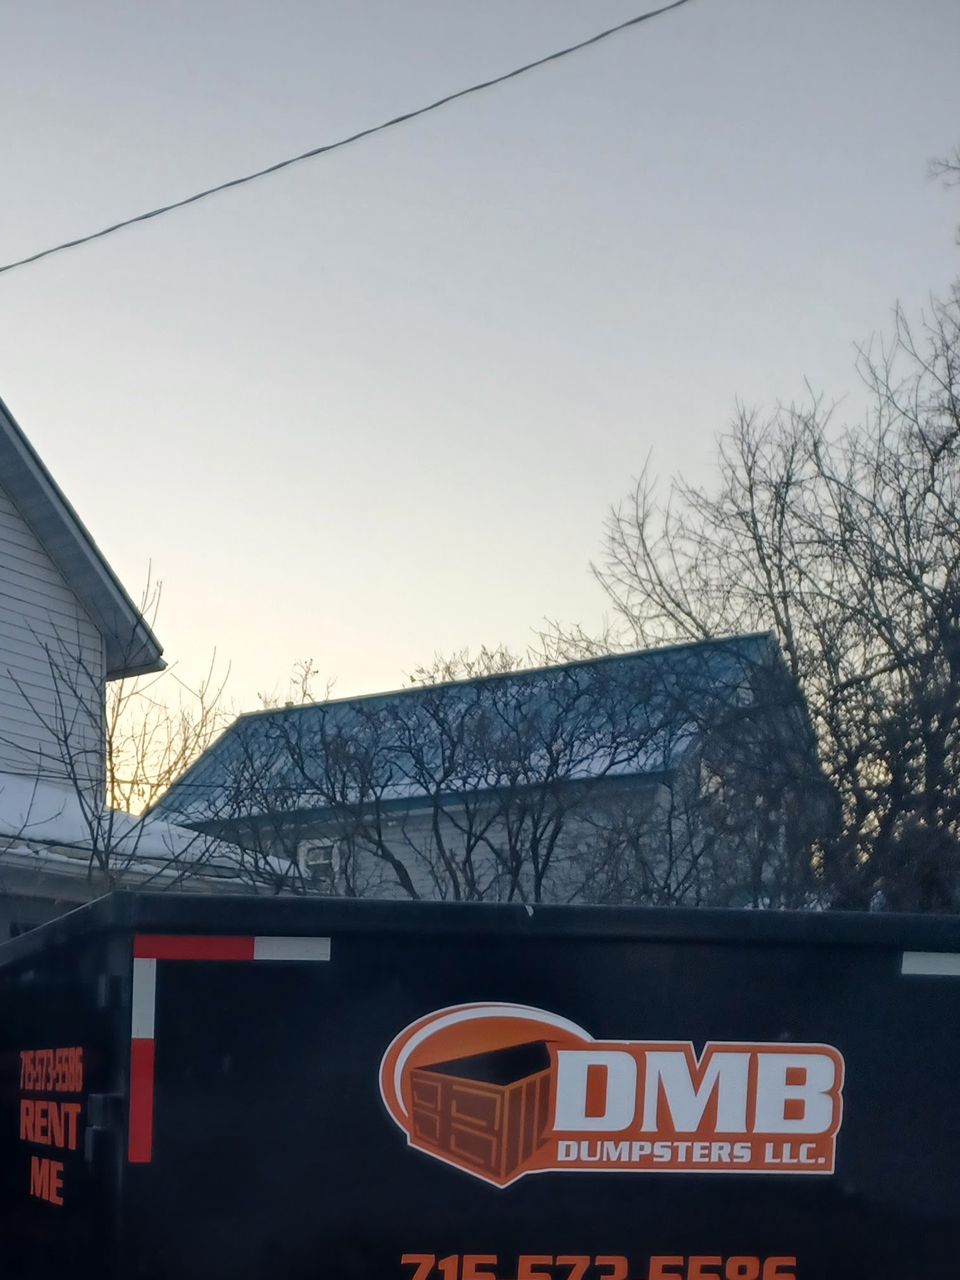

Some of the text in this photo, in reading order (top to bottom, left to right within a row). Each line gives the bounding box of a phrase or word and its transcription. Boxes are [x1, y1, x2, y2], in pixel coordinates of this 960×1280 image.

[553, 1050, 837, 1134] DMB
[20, 1099, 81, 1150] RENT
[557, 1141, 826, 1164] DUMPSTERS LLC.
[30, 1155, 64, 1206] ME
